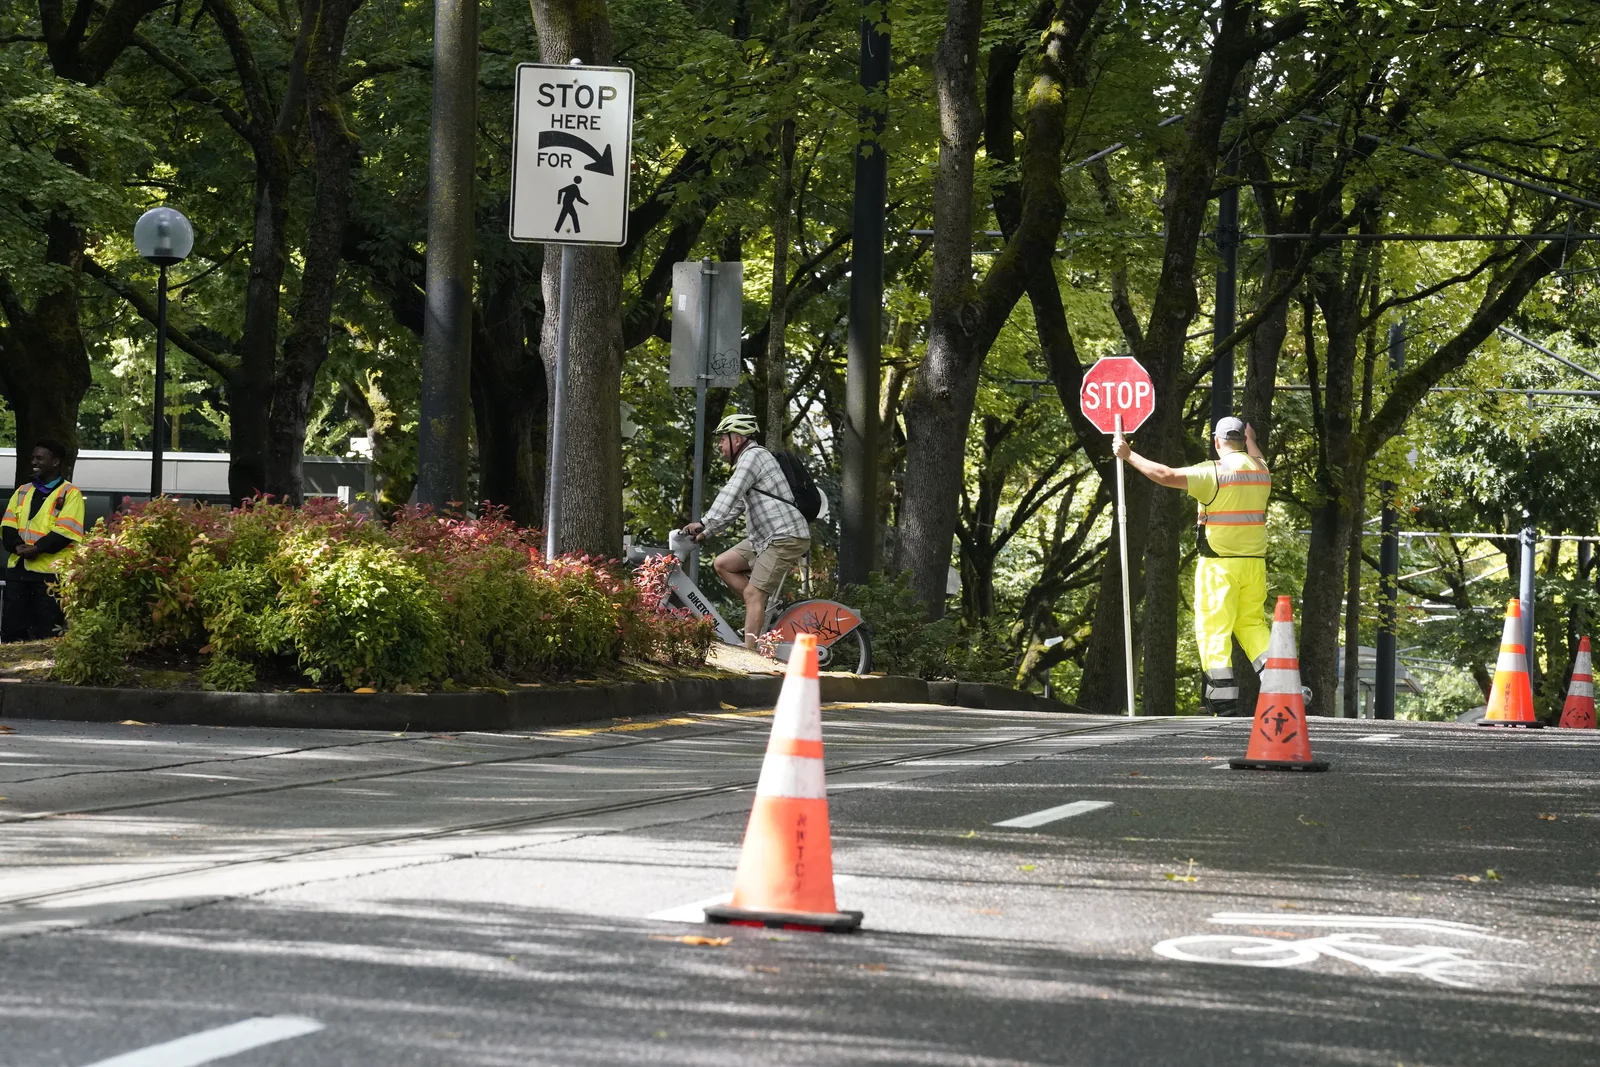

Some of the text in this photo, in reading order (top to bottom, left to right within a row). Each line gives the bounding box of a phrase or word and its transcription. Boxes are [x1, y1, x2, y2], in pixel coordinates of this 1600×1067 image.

[536, 82, 617, 110] STOP
[551, 113, 601, 130] HERE
[537, 152, 572, 168] FOR
[1085, 381, 1150, 410] STOP
[687, 591, 721, 629] BIKETON
